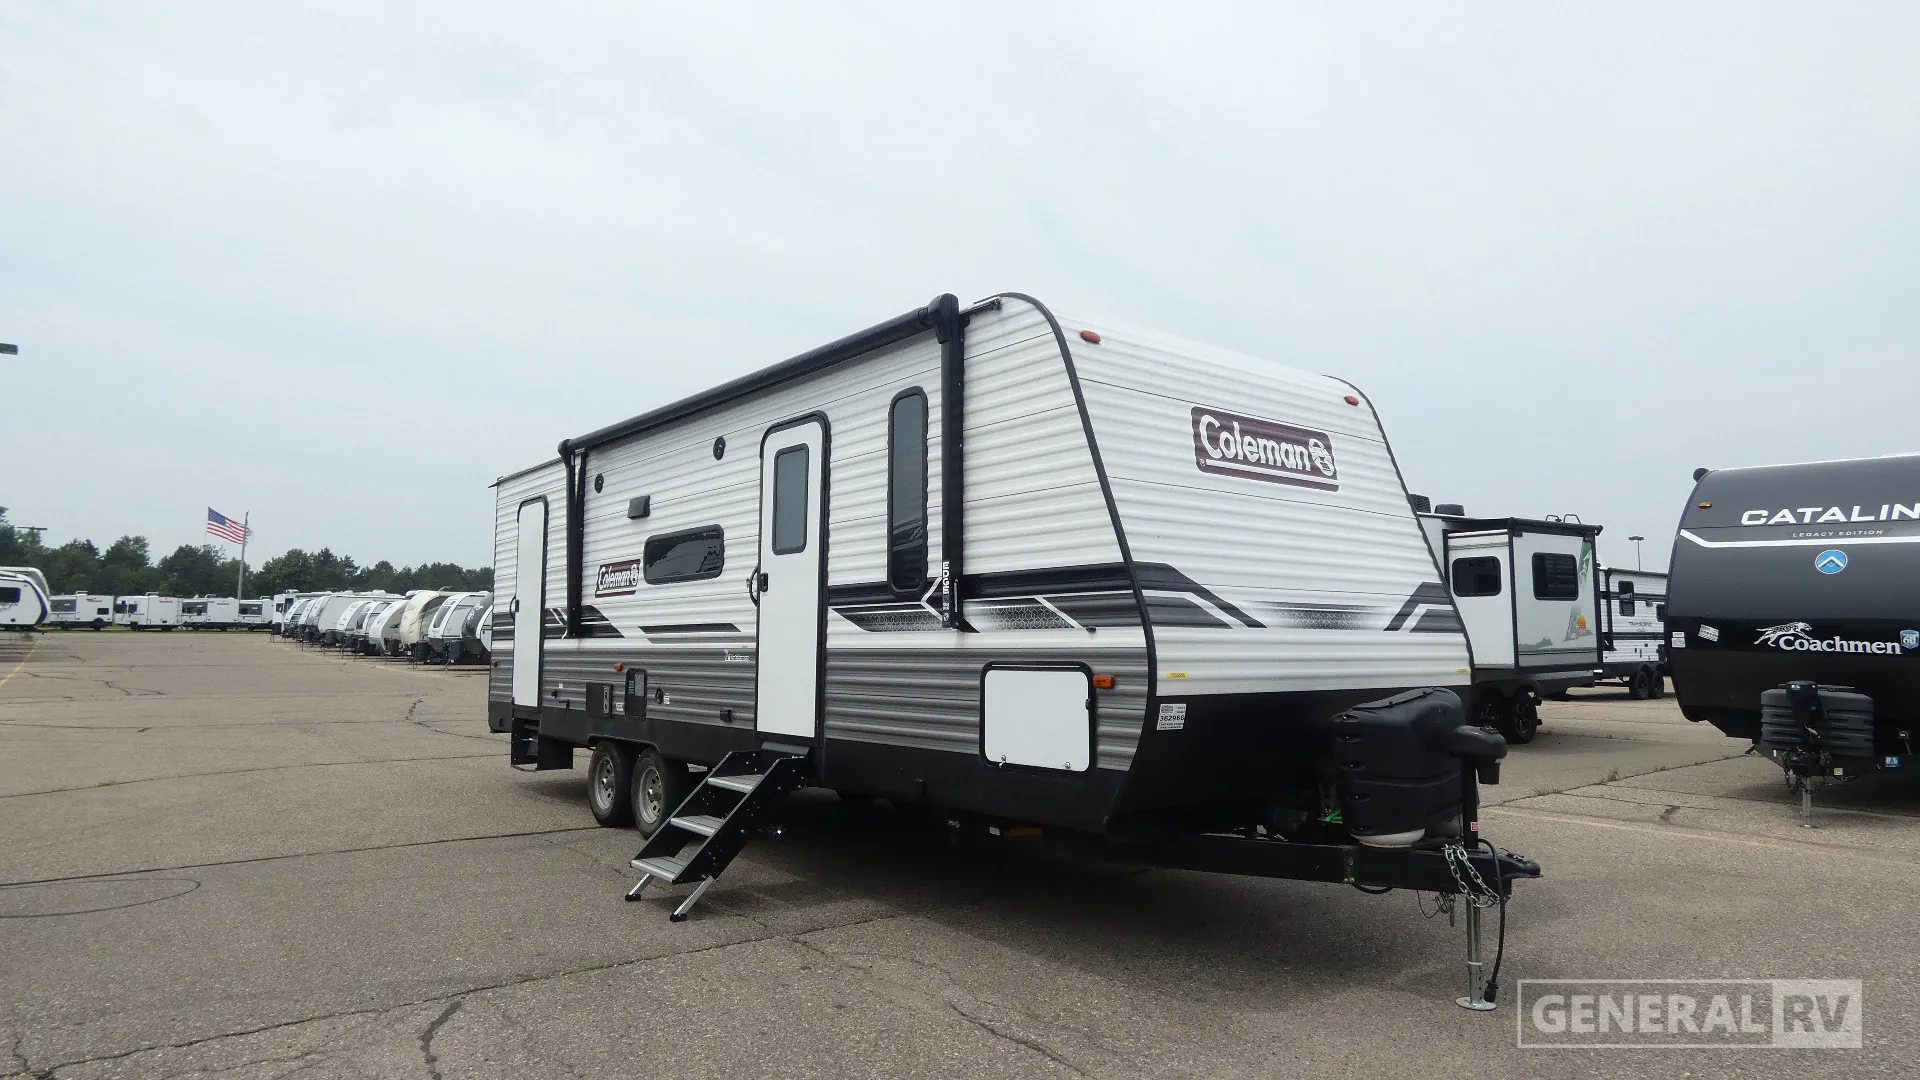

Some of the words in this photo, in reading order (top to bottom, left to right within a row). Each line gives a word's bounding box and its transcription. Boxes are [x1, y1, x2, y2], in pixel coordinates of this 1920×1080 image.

[1200, 414, 1312, 472] Coleman
[598, 565, 631, 590] Coleman
[942, 561, 950, 595] EDGE
[1779, 635, 1902, 654] Coachmen
[1903, 636, 1916, 645] 60
